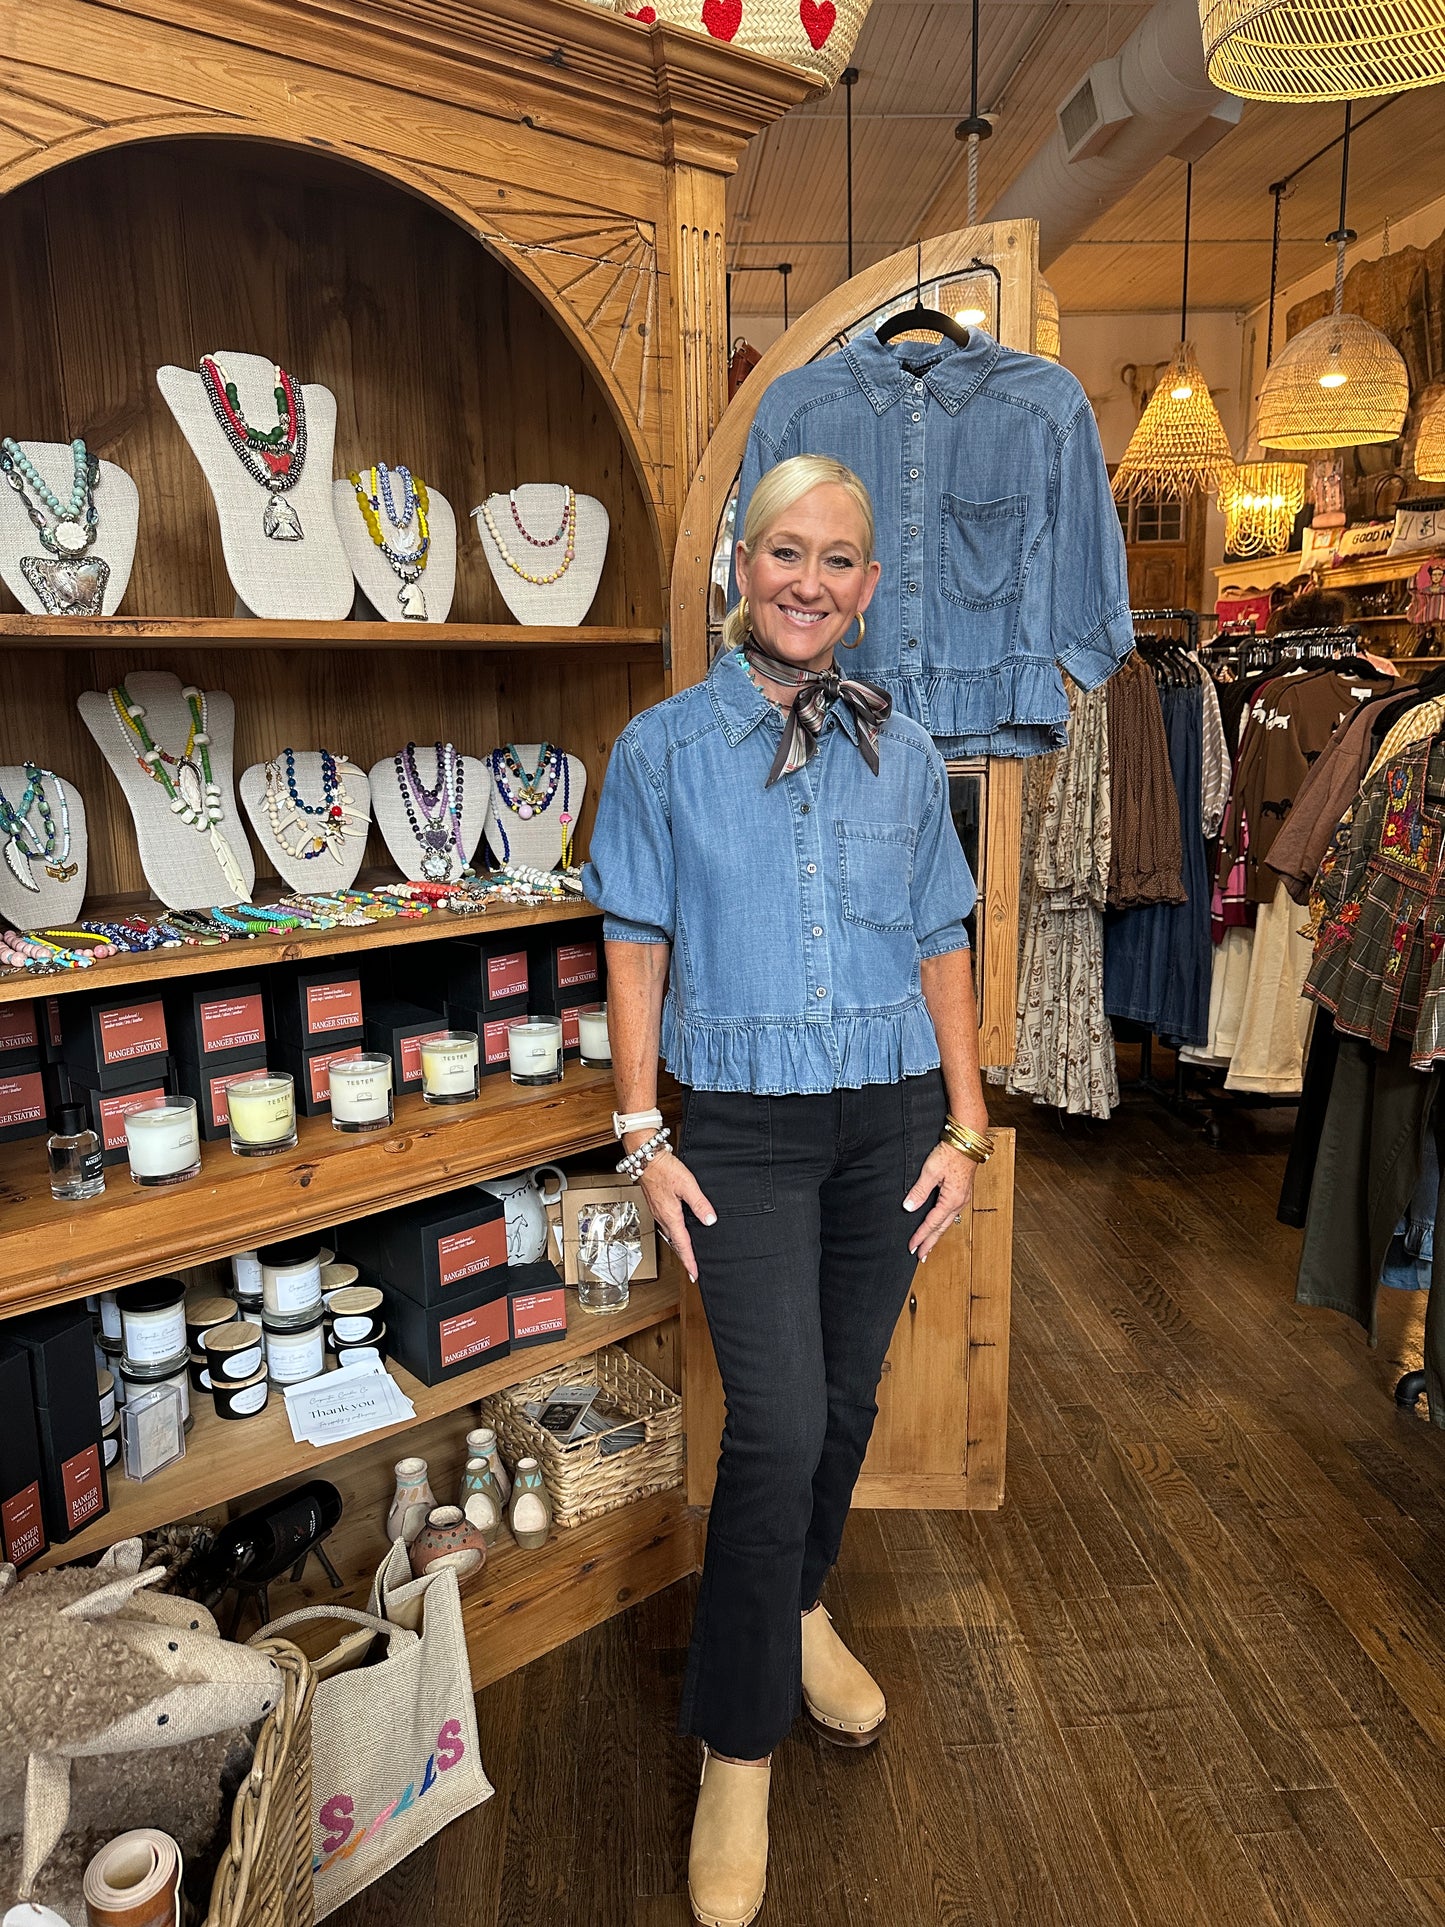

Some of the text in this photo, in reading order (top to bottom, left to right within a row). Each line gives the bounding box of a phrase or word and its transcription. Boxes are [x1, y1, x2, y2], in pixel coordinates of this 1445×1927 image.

[1352, 530, 1380, 545] GOOD
[560, 975, 578, 985] RANGER
[578, 972, 596, 982] STATION
[492, 987, 510, 997] RANGER
[509, 983, 527, 993] STATION
[312, 1019, 336, 1030] RANGER
[336, 1015, 360, 1026] STATION
[5, 1035, 33, 1047] STATION
[207, 1037, 234, 1049] RANGER
[234, 1032, 260, 1044] STATION
[108, 1047, 135, 1060] RANGER
[135, 1040, 162, 1053] STATION
[443, 1053, 468, 1061] TESTER
[346, 1077, 374, 1086] TESTER
[13, 1109, 41, 1121] STATION
[107, 1135, 127, 1146] RANG
[443, 1268, 467, 1282] RANGER
[467, 1259, 490, 1273] STATION
[517, 1320, 563, 1336] RANGER STATION
[445, 1338, 490, 1363] RANGER STATION
[309, 1403, 349, 1419] Thank
[351, 1399, 376, 1412] you
[72, 1486, 98, 1511] RANGER
[73, 1495, 99, 1519] STATION
[11, 1525, 39, 1551] RANGER
[12, 1535, 40, 1560] STATION
